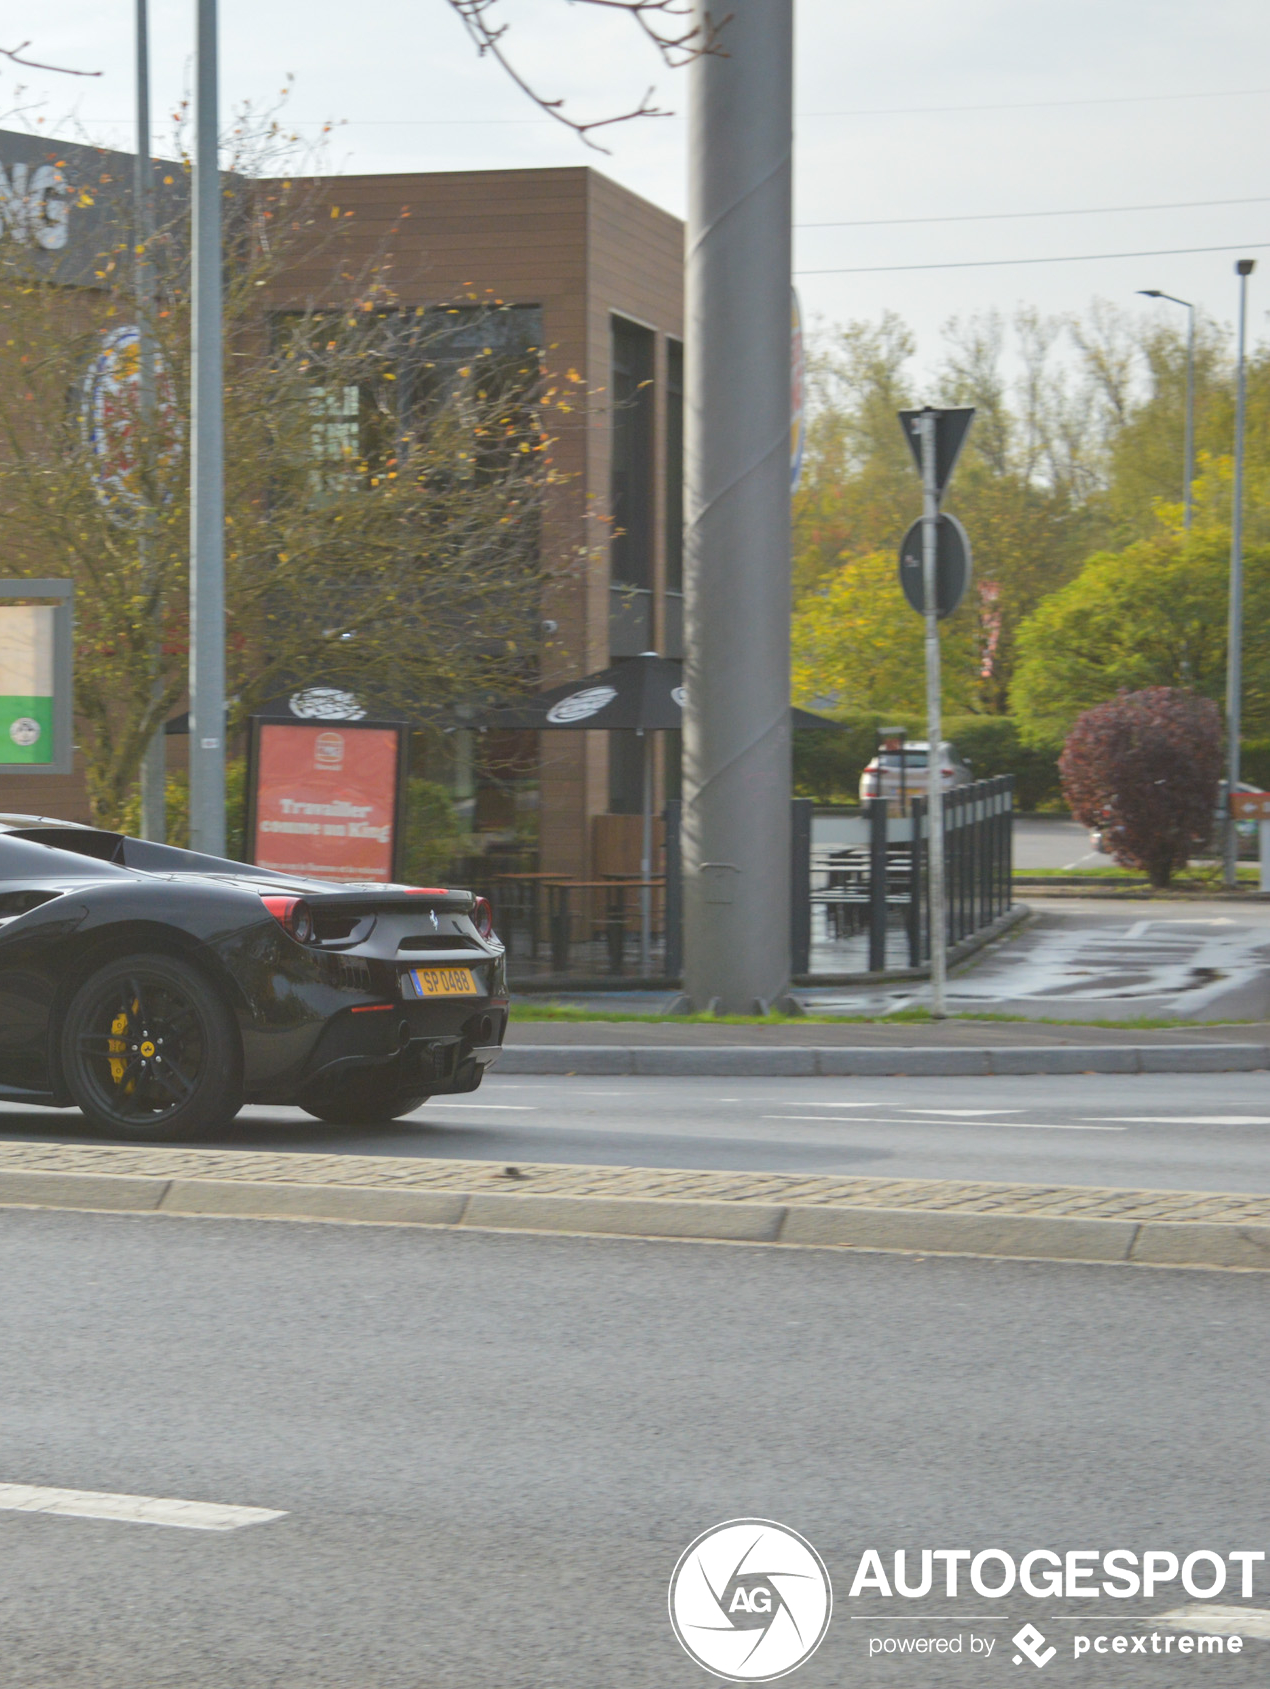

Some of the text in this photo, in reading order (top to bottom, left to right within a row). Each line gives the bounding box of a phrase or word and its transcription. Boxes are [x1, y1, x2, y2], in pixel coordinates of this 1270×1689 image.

[280, 798, 373, 819] Travailler
[259, 820, 321, 836] comme
[348, 821, 391, 843] King
[423, 971, 439, 992] SP
[440, 970, 470, 991] 0488
